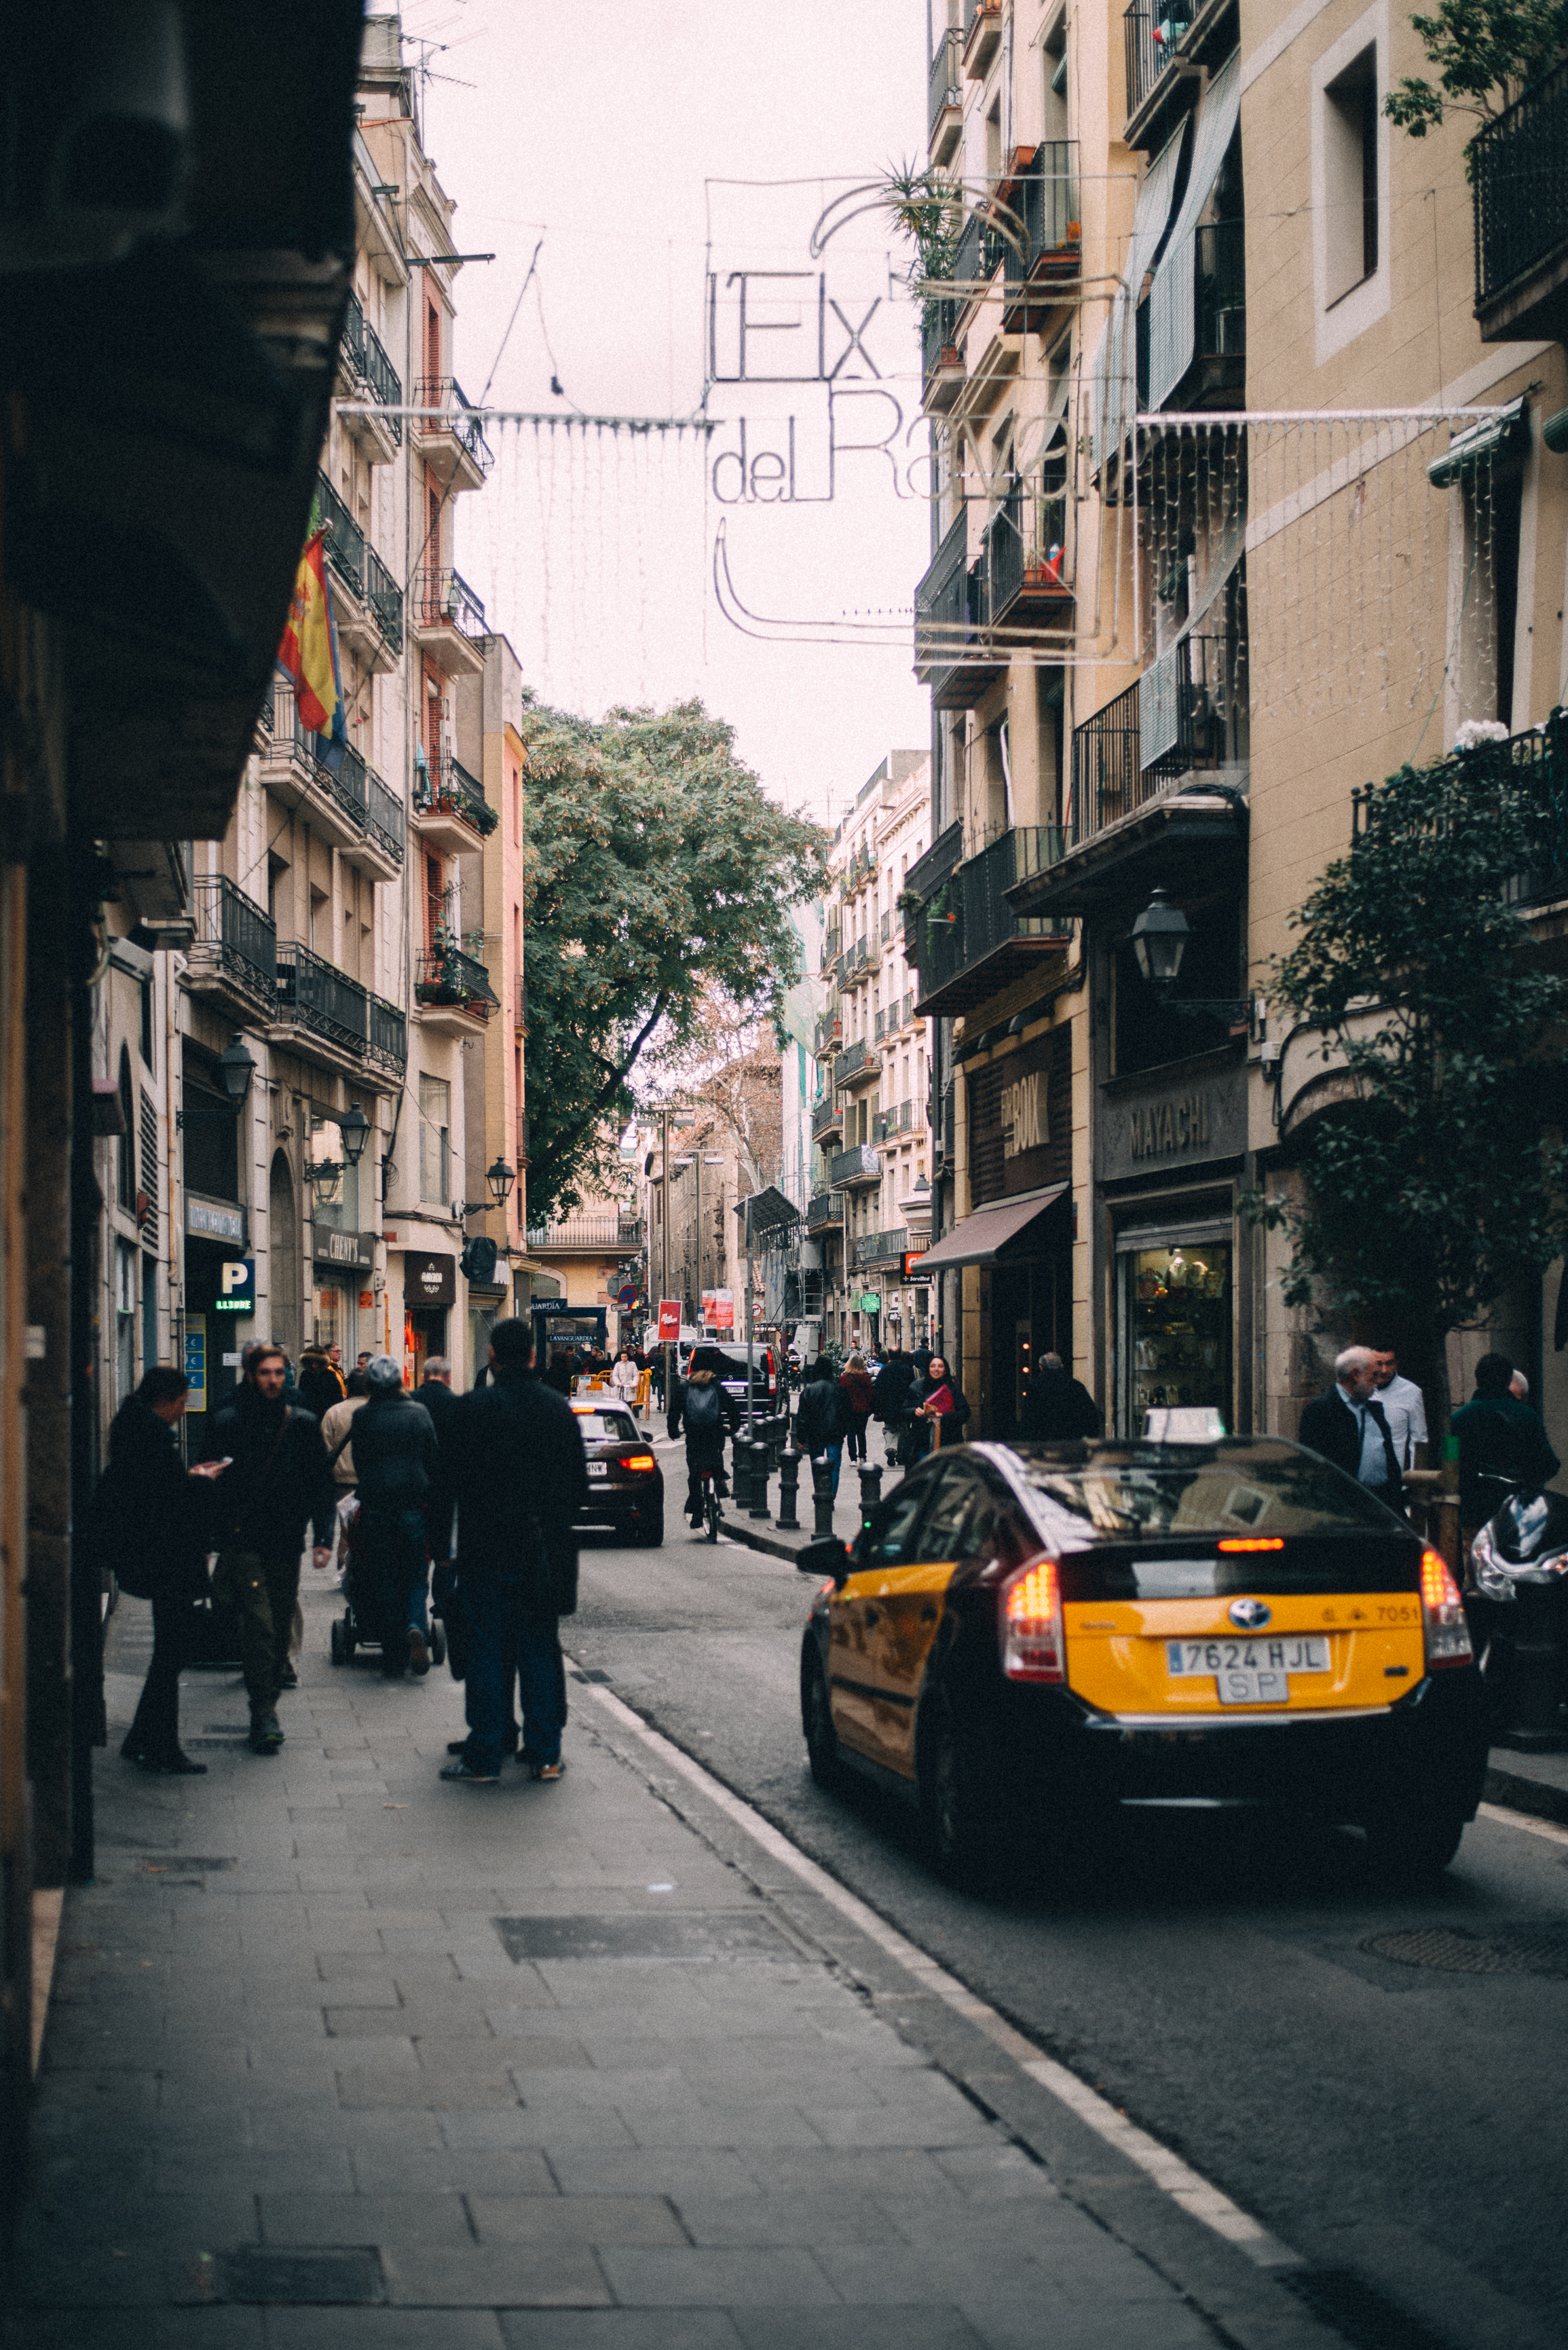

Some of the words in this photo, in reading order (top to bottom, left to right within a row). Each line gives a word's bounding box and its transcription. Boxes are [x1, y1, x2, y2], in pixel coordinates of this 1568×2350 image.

[1132, 1094, 1208, 1158] MAYACHI
[222, 1262, 248, 1293] P
[530, 1302, 560, 1310] UARDIA
[1377, 1606, 1418, 1621] 7051
[1187, 1643, 1257, 1670] 7624
[1268, 1642, 1322, 1668] HJL
[1228, 1672, 1277, 1699] SP
